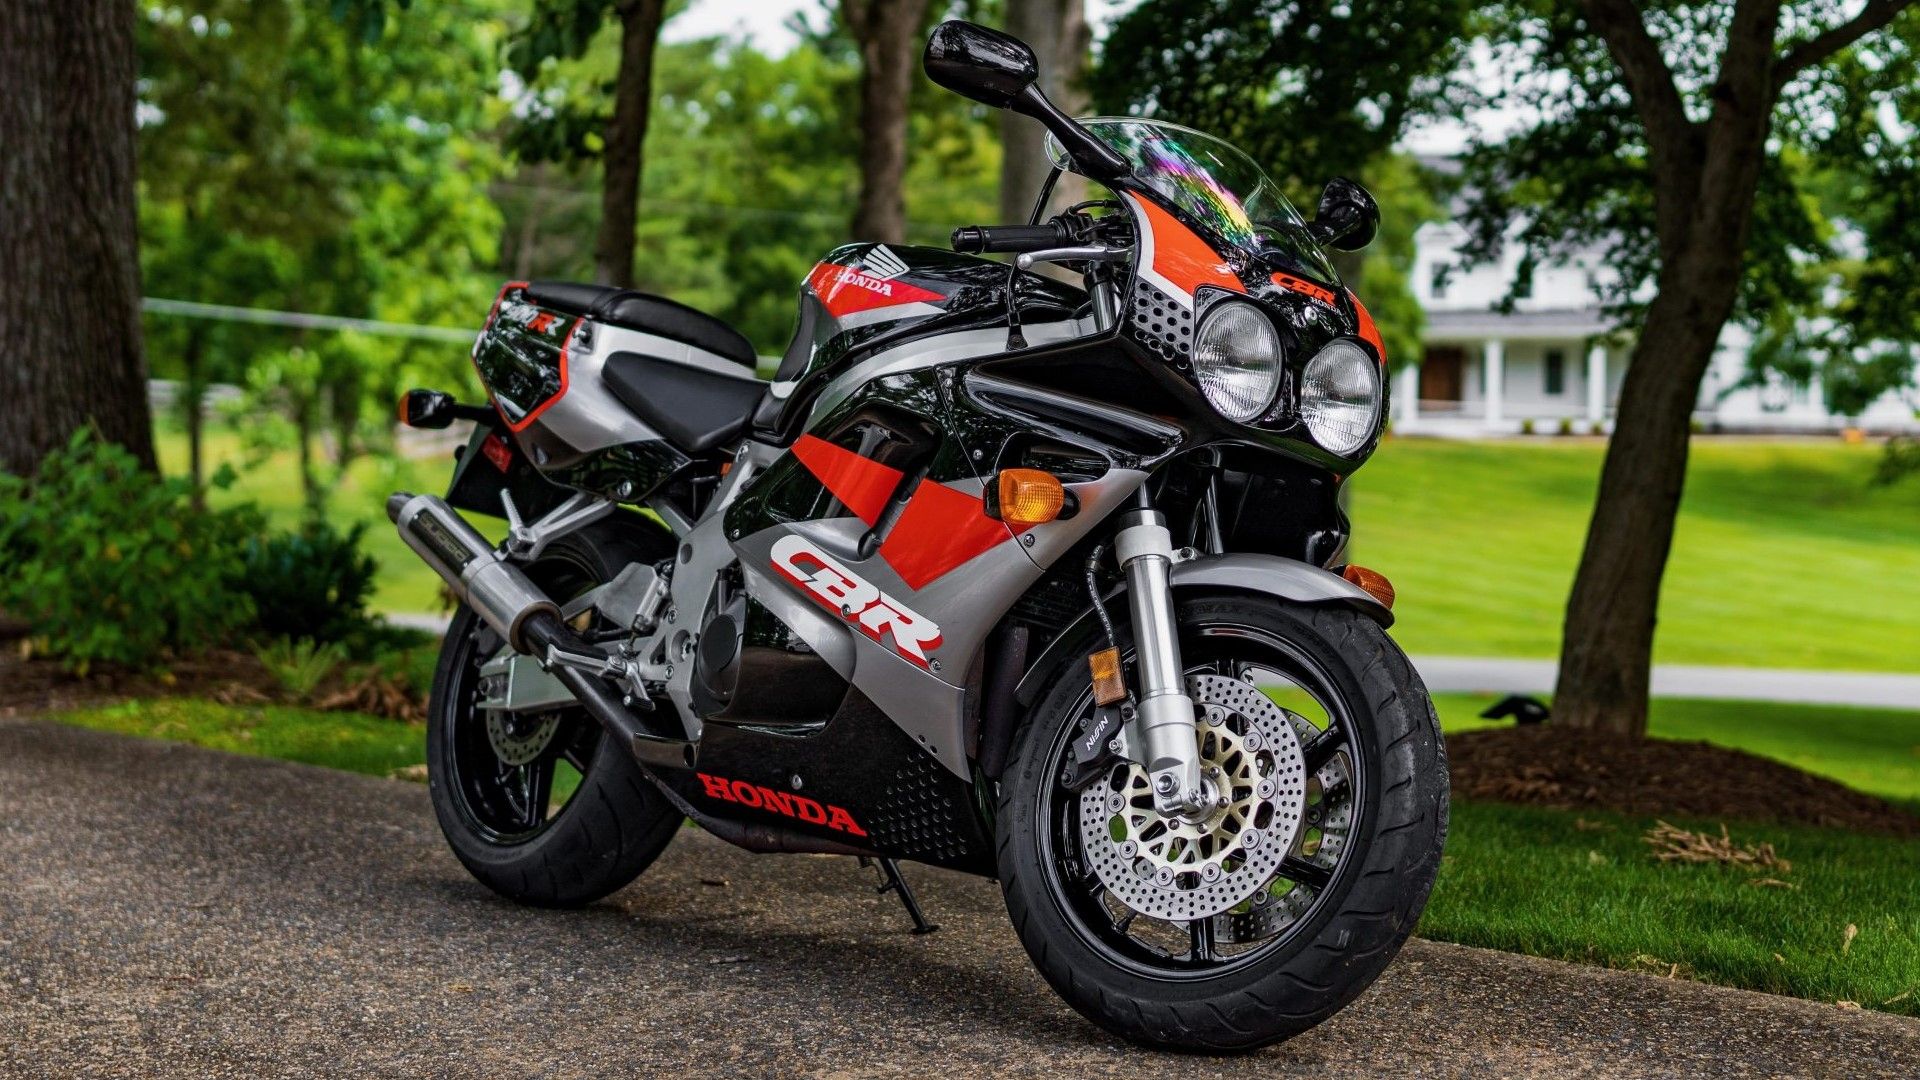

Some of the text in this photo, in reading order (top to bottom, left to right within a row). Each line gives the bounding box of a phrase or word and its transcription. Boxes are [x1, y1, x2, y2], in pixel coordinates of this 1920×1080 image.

[1270, 271, 1336, 306] CBR
[769, 534, 943, 672] CBR
[697, 773, 867, 837] HONDA
